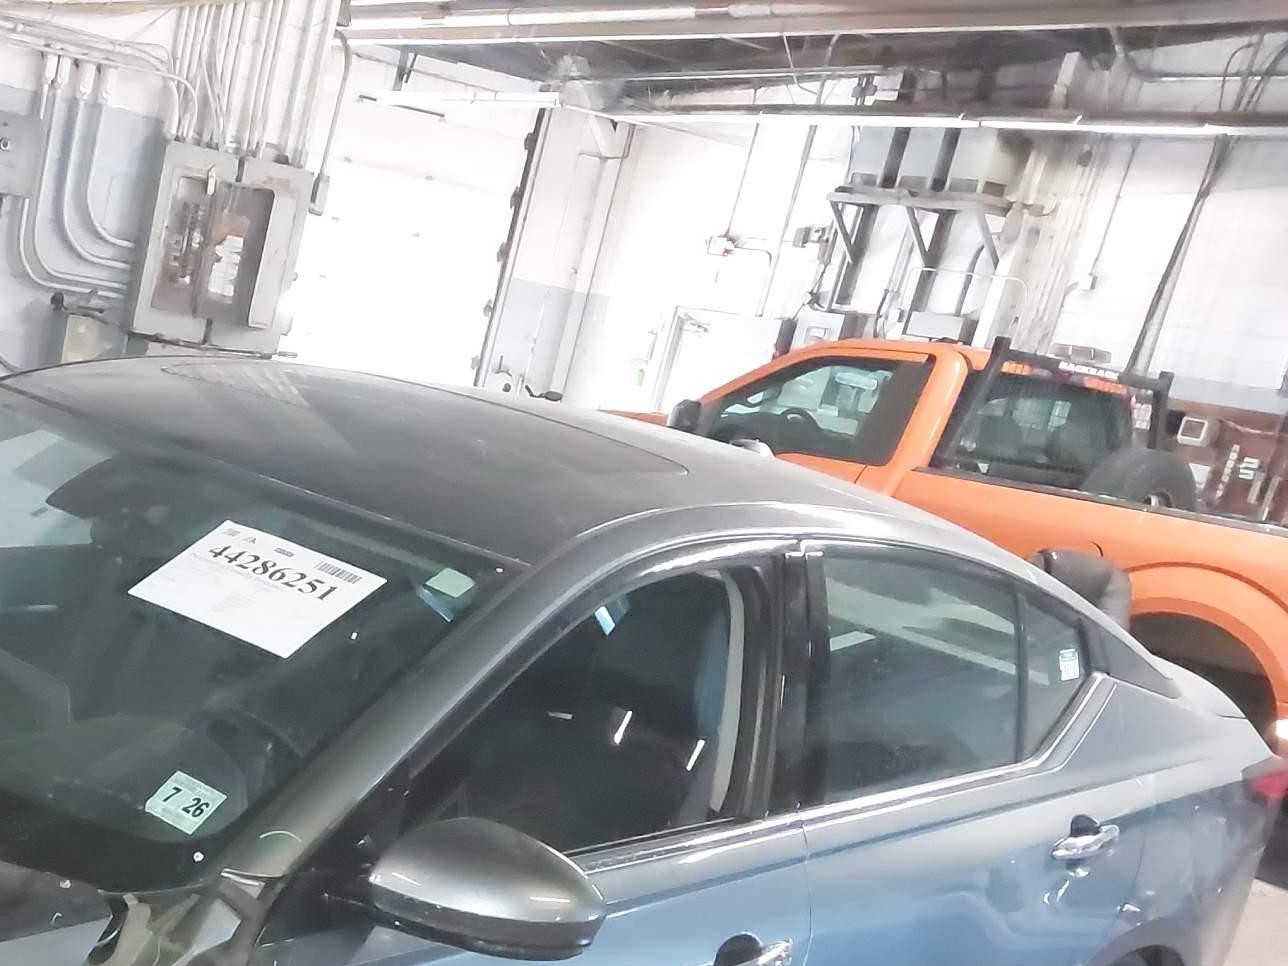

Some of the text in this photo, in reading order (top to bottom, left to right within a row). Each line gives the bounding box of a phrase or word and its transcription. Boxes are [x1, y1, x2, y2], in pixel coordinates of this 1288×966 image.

[209, 545, 338, 600] 44286251
[162, 786, 183, 803] 7
[182, 797, 210, 818] 26
